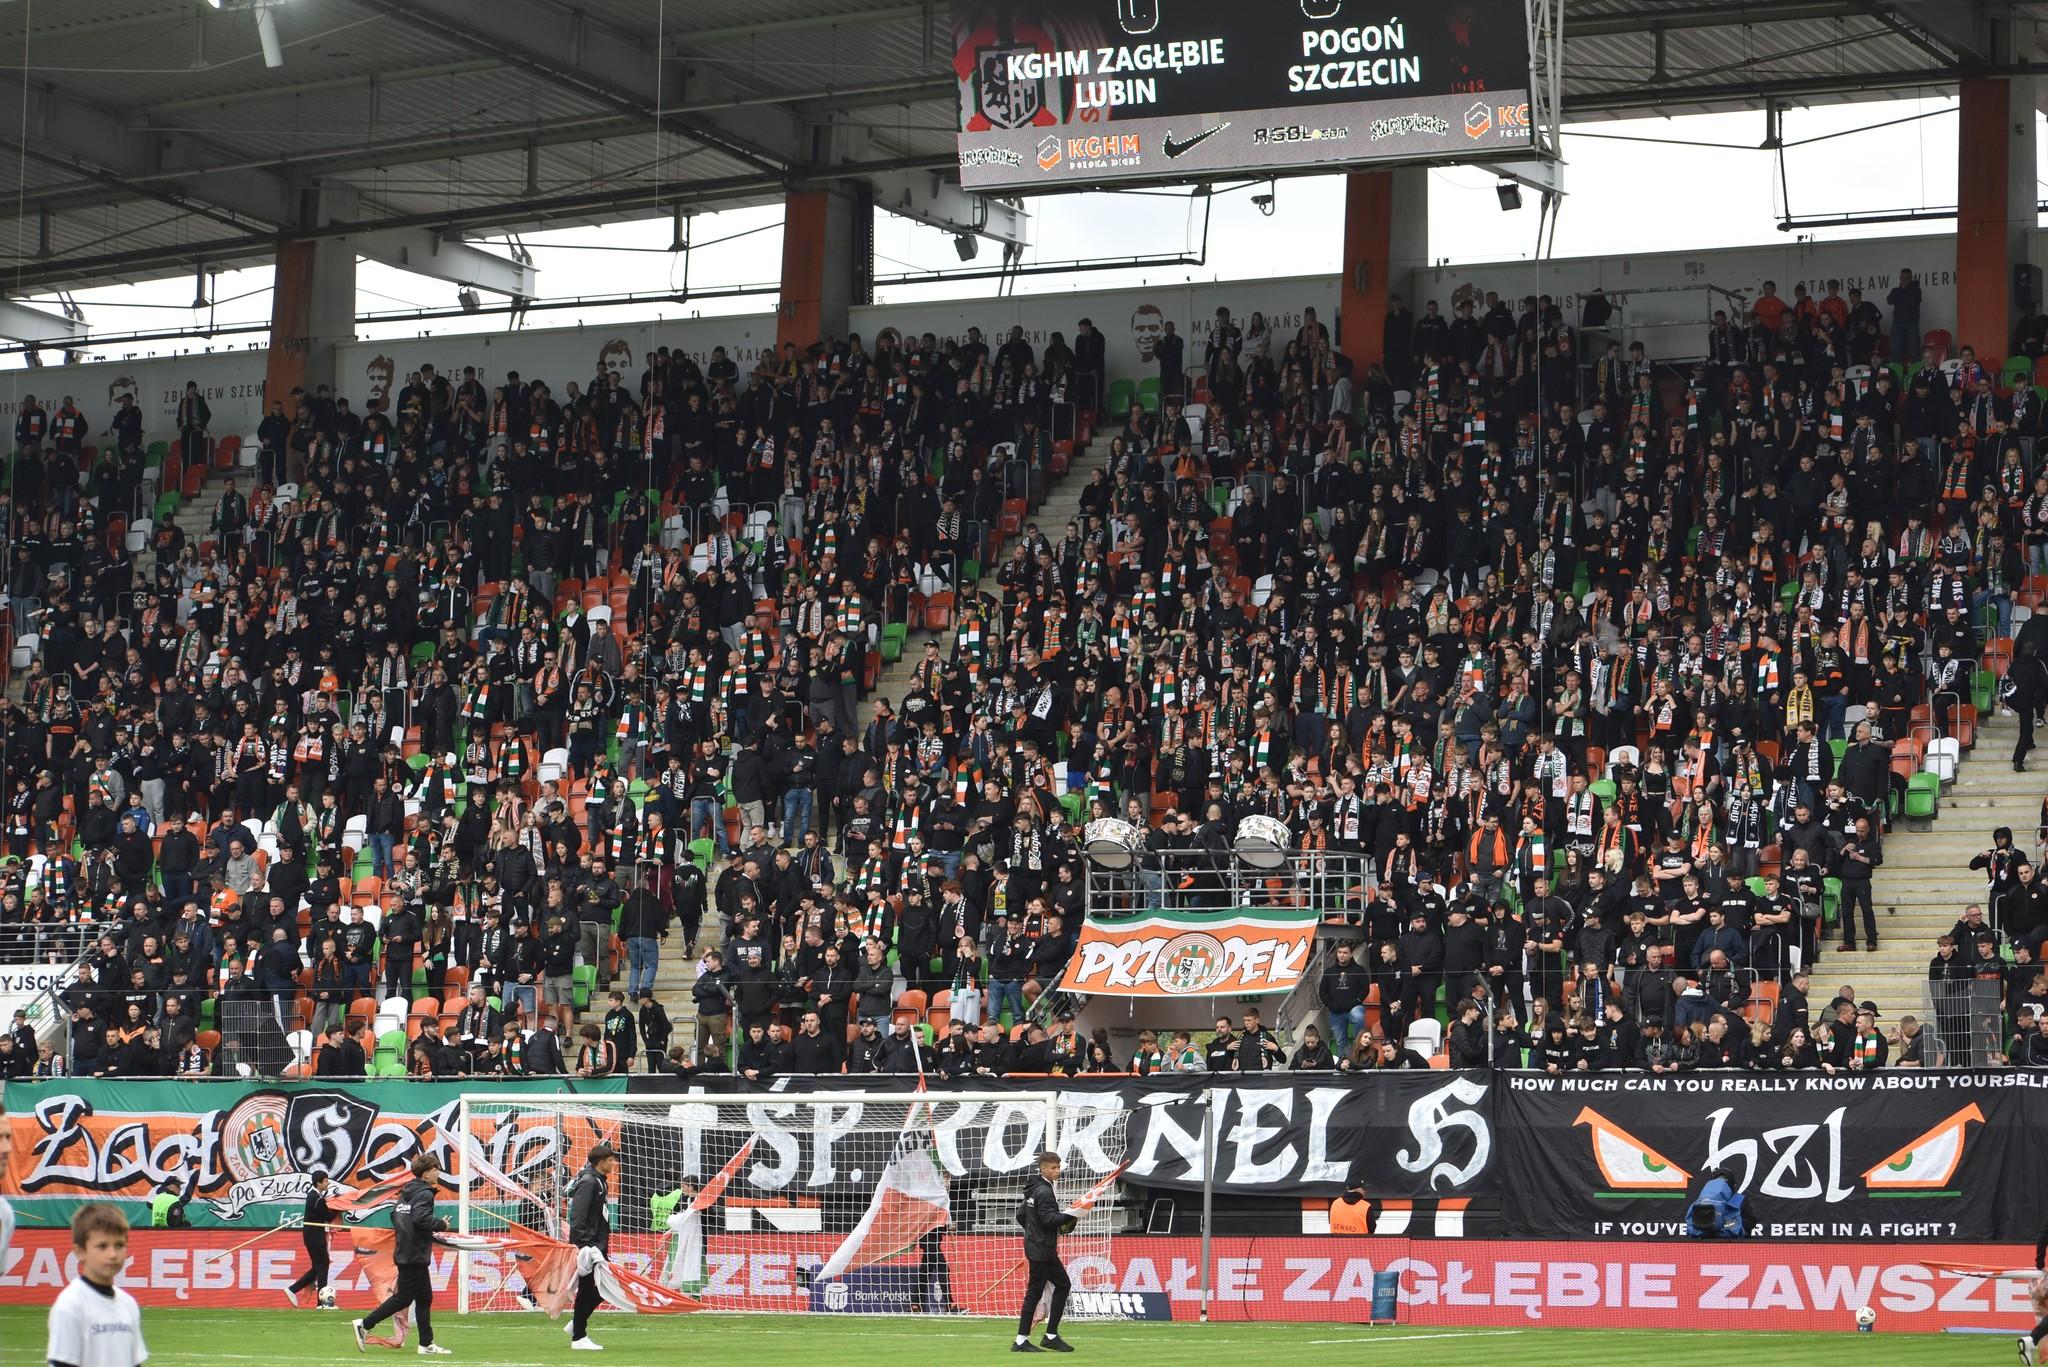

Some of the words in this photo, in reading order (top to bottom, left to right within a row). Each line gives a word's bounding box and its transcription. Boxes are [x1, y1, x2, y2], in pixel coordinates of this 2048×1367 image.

[1302, 17, 1405, 56] POGOŃ
[1007, 48, 1089, 81] KGHM
[1096, 38, 1225, 74] ZAGŁĘBIE
[1288, 56, 1420, 92] SZCZECIN
[1075, 78, 1156, 109] LUBIN
[1067, 134, 1141, 158] KGHM
[1510, 1077, 1554, 1091] HOW
[1561, 1078, 1617, 1092] MUCH
[1624, 1078, 1667, 1092] CAN
[1673, 1078, 1714, 1092] YOU
[1721, 1078, 1799, 1092] REALLY
[1806, 1077, 1866, 1091] KNOW
[1872, 1076, 1941, 1090] ABOUT
[1594, 1222, 1613, 1235] IF
[1771, 1223, 1824, 1236] BEEN
[1832, 1223, 1852, 1236] IN
[1859, 1223, 1873, 1236] A
[1880, 1223, 1942, 1236] FIGHT
[1948, 1222, 1957, 1236] ?
[855, 1290, 880, 1302] Bank
[1283, 1257, 1678, 1319] ZAGŁĘBIE
